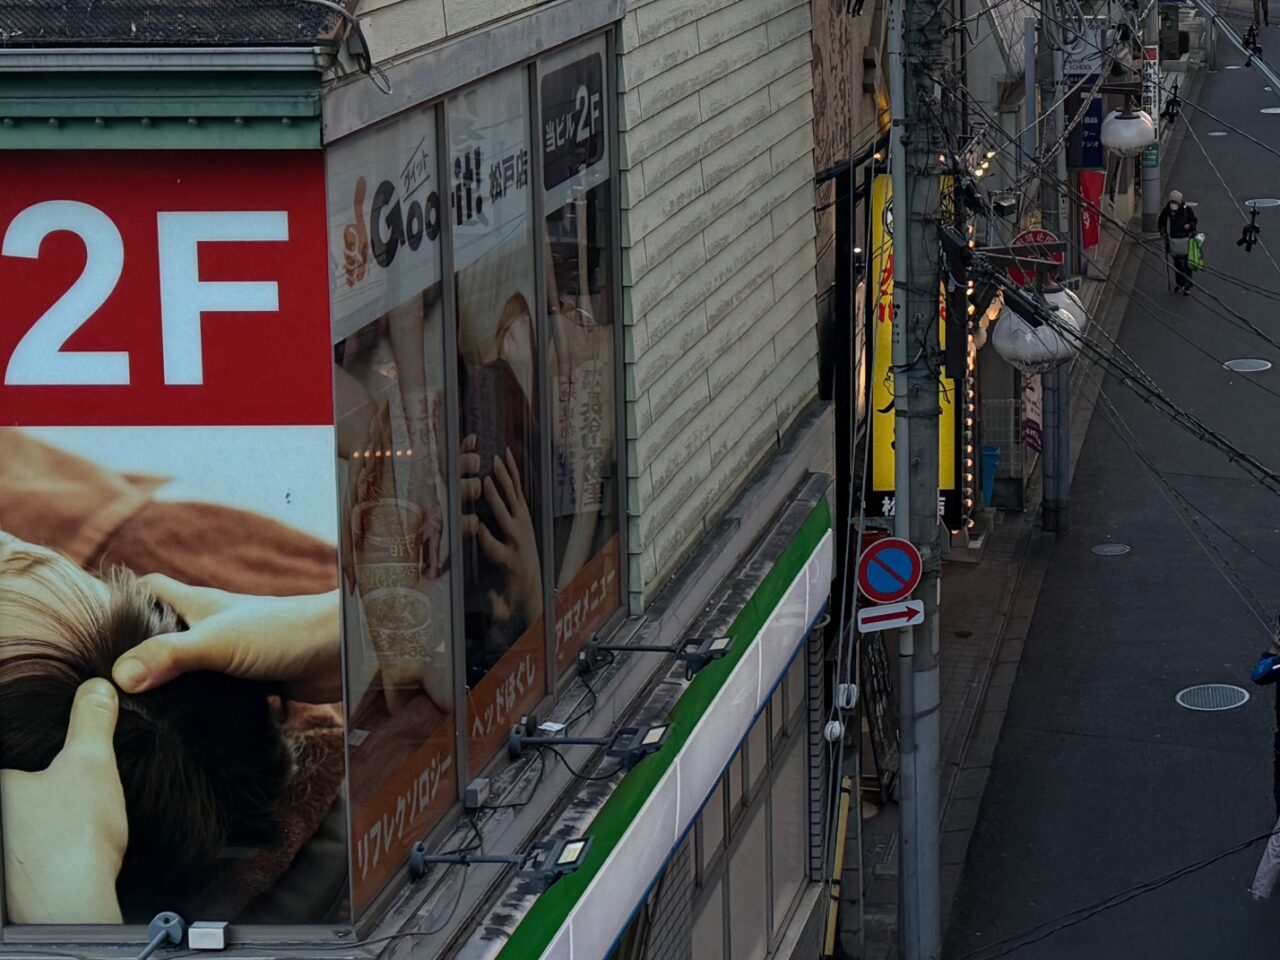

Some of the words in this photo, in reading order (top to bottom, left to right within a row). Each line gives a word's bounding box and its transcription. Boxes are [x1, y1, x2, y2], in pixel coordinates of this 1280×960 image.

[545, 85, 600, 154] 当ビル2F
[2, 200, 290, 386] 2F
[555, 569, 616, 653] アロマメニュー
[470, 652, 537, 739] ヘッドほぐし
[356, 751, 453, 882] リフレクソロジー
